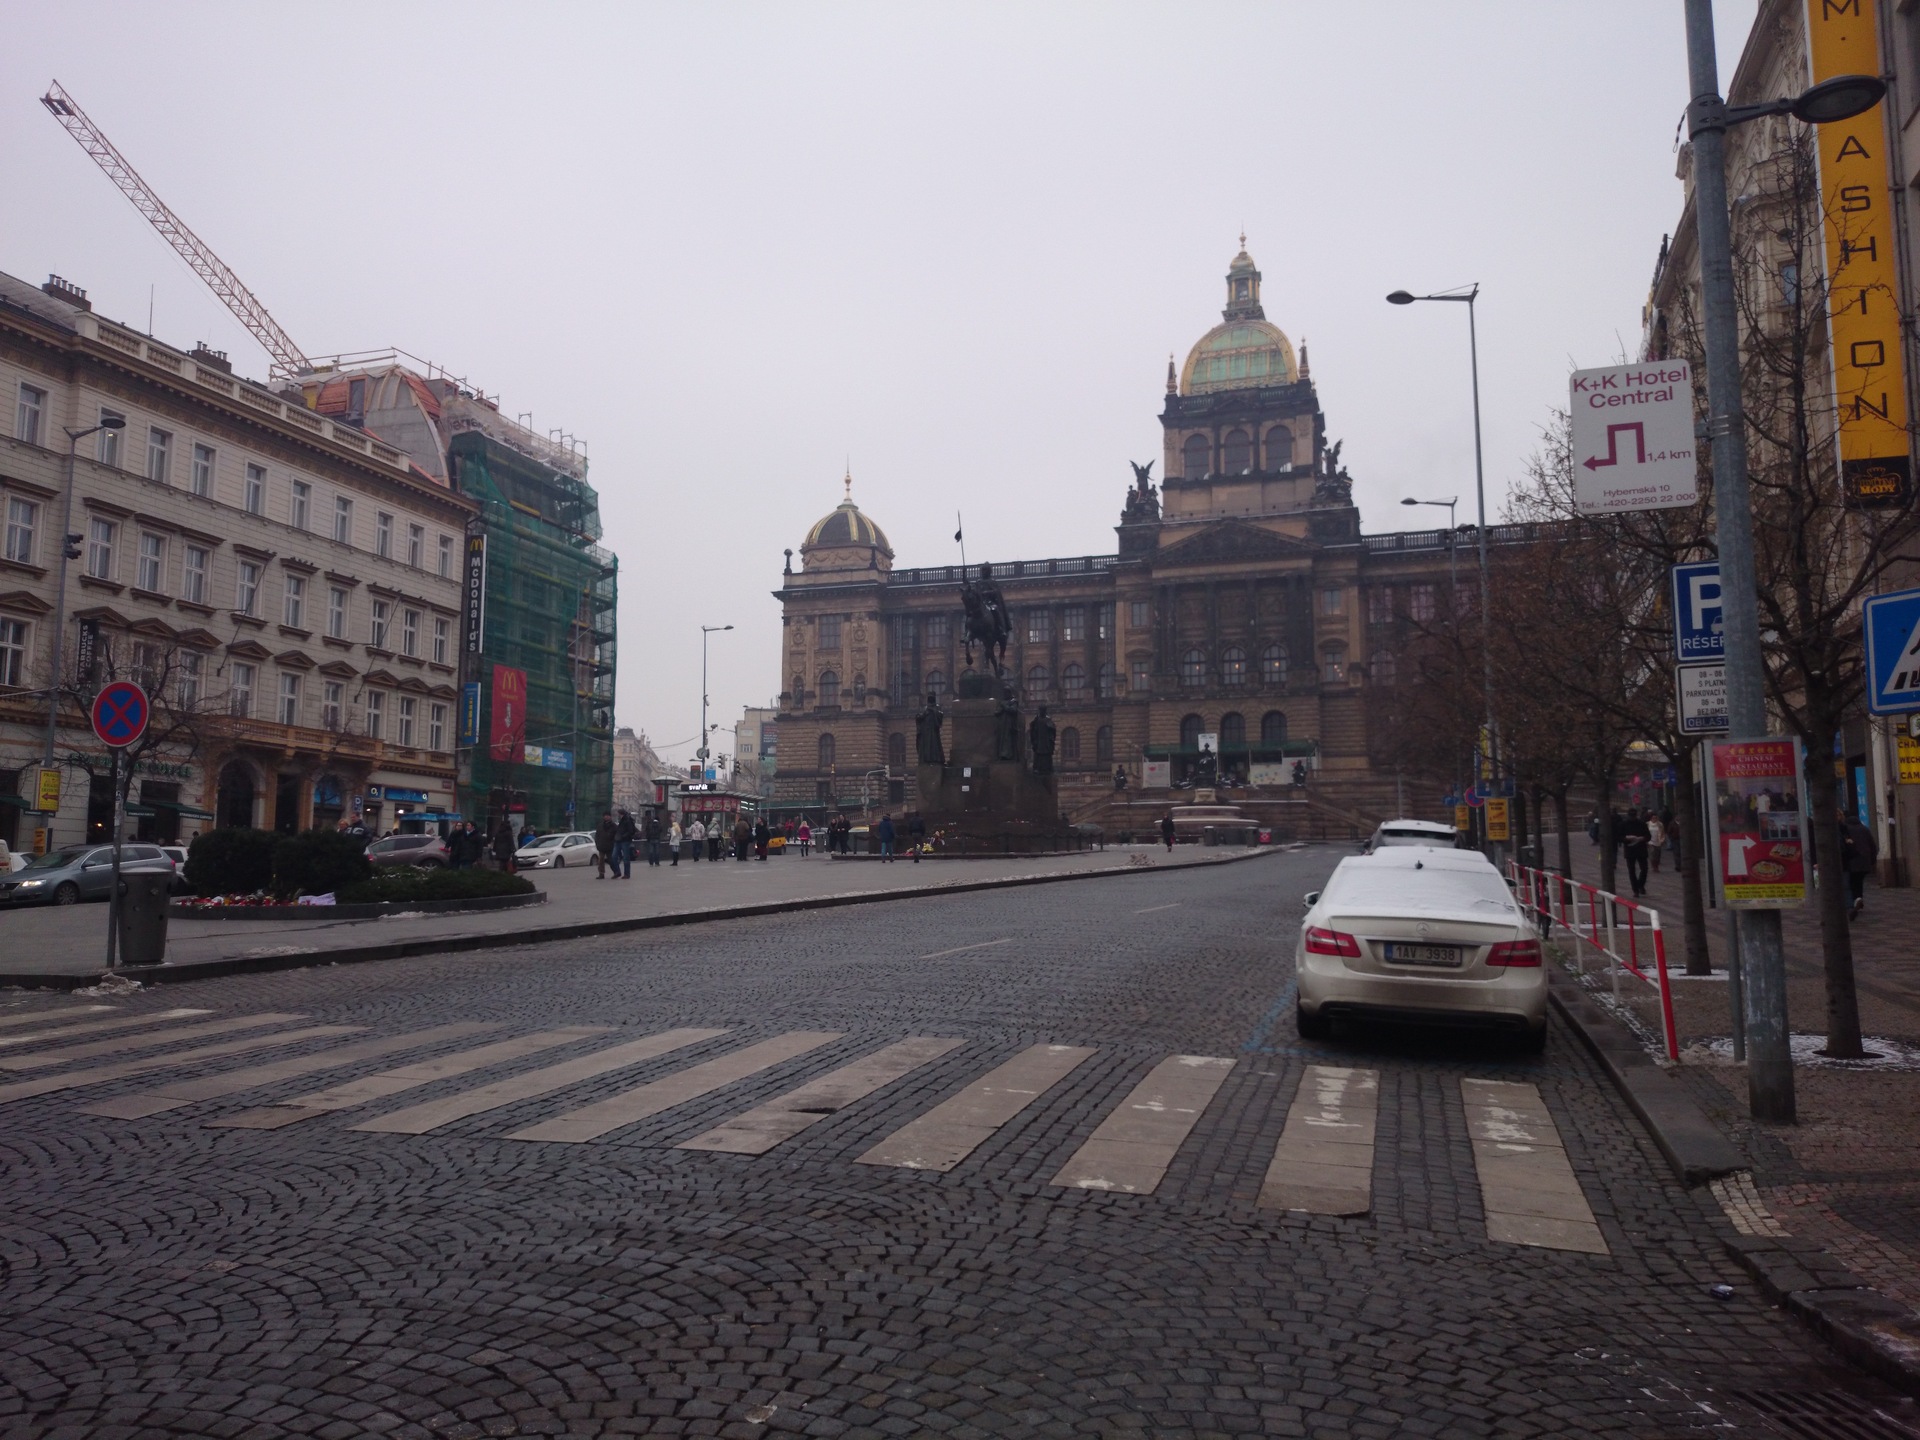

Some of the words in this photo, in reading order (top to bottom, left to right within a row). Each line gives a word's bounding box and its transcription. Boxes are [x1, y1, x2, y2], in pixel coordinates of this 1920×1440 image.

[1835, 136, 1888, 420] ASHION
[1573, 374, 1618, 393] K+K
[1626, 366, 1687, 387] Hotel
[1589, 386, 1673, 409] Central
[1647, 451, 1666, 463] 1,4
[1670, 450, 1691, 460] km
[1659, 484, 1670, 492] 10
[1660, 494, 1673, 503] 22
[1676, 492, 1696, 501] 000
[1730, 762, 1784, 770] RESTAURANT
[1396, 946, 1416, 958] 1AV
[1426, 948, 1455, 961] 3938
